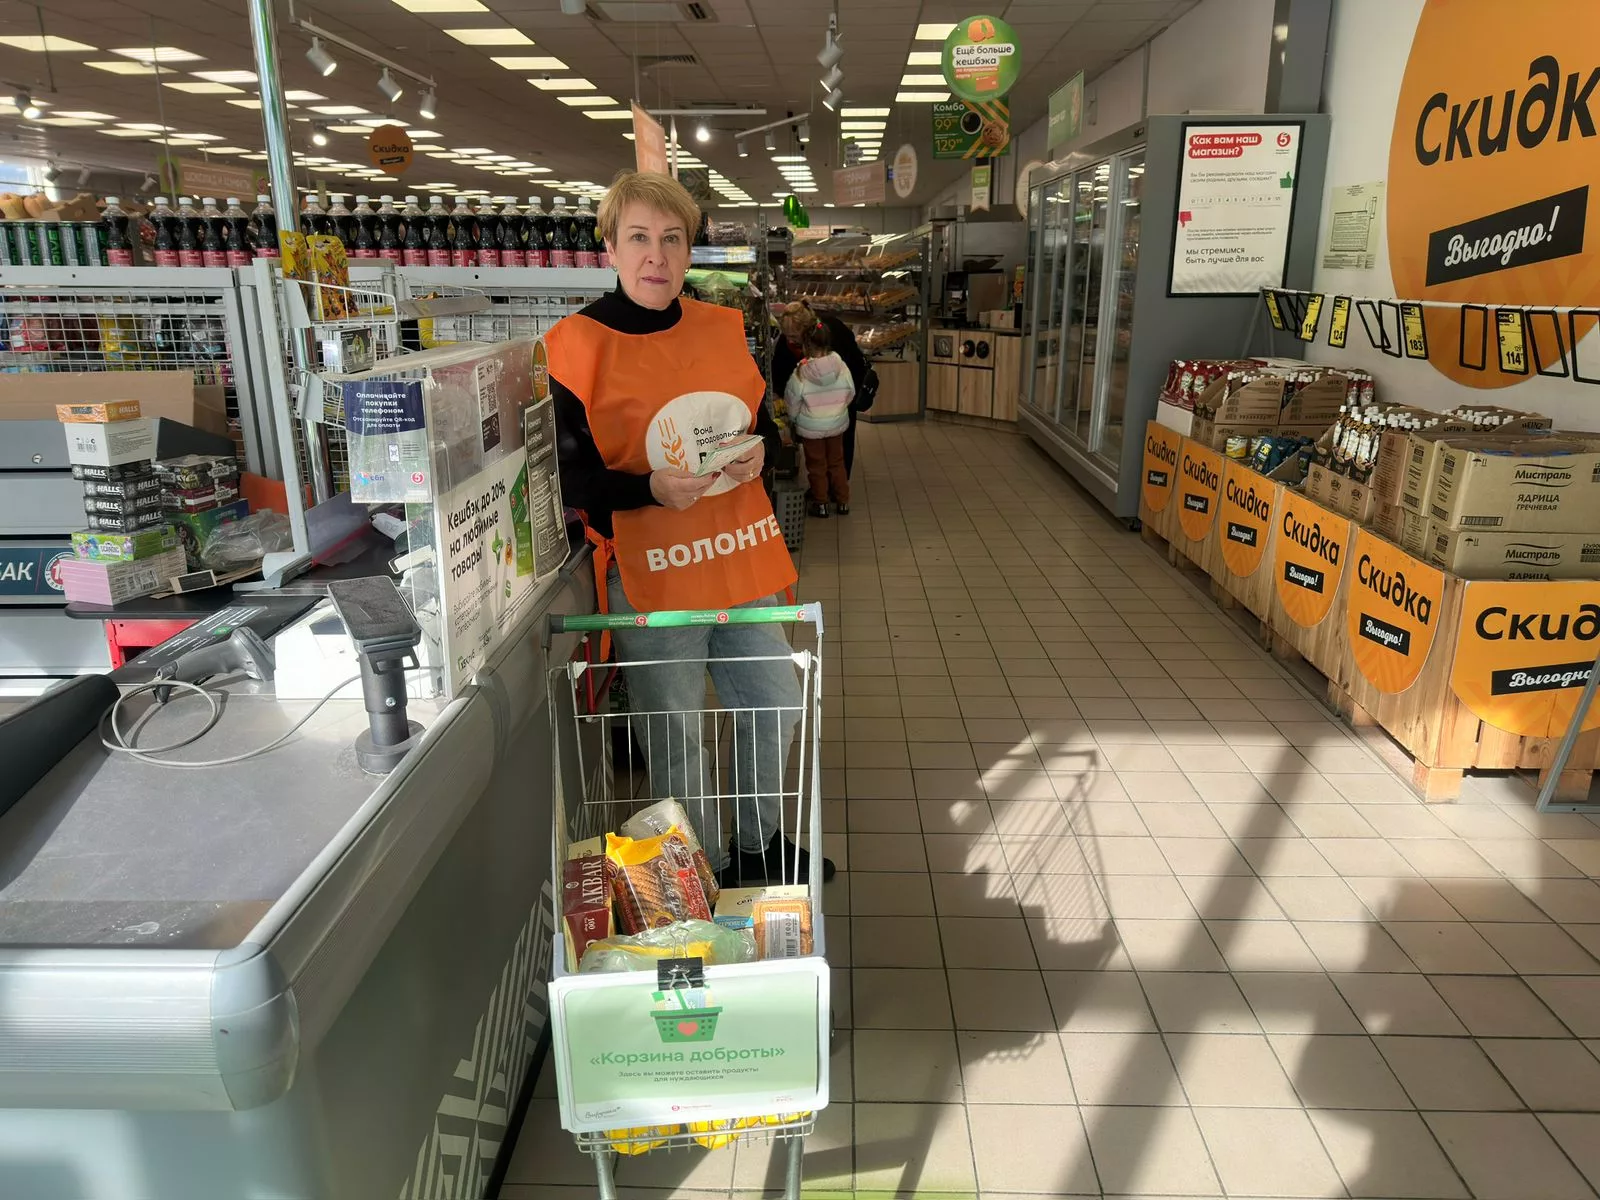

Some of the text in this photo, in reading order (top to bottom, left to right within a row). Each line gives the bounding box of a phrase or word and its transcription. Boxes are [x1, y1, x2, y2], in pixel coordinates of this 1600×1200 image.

[956, 45, 1012, 55] Ещё больше
[956, 57, 997, 65] кешбэка
[933, 102, 964, 112] Комбо
[1192, 136, 1258, 145] Как вам наш
[372, 144, 409, 153] Скидка
[1192, 147, 1240, 156] магазин?
[1444, 205, 1560, 266] Выгодно!
[1200, 247, 1245, 255] стремимся
[1185, 256, 1206, 264] быть
[1207, 256, 1234, 264] лучше
[1409, 339, 1423, 351] 183
[1506, 351, 1522, 366] 114
[356, 392, 406, 400] Оплачивайте
[360, 408, 404, 416] телефоном
[693, 426, 713, 436] Фонд
[1147, 436, 1176, 466] Скидка
[84, 468, 106, 477] HALLS
[1183, 454, 1219, 492] Скидка
[1515, 470, 1572, 482] Мистраль
[97, 485, 121, 493] HALLS
[137, 478, 160, 491] HALLS
[136, 494, 159, 507] HALLS
[1226, 478, 1270, 522] Скидка
[1517, 493, 1560, 503] ЯДРИЦА
[96, 501, 119, 510] HALLS
[447, 478, 506, 532] Кешбэк до 20%
[99, 518, 121, 526] HALLS
[139, 511, 163, 523] HALLS
[449, 538, 461, 558] на
[462, 510, 499, 547] любимые
[1231, 525, 1253, 542] Выгодно!
[1283, 511, 1340, 566] Скидка
[646, 514, 782, 572] ВОЛОНТЕ
[1505, 549, 1561, 562] Мистраль
[0, 562, 34, 581] АК
[1289, 565, 1319, 586] Выгодно!
[1358, 553, 1432, 625] Скидка
[1475, 604, 1600, 641] Скид
[1365, 619, 1403, 646] Выгодно!
[581, 859, 604, 905] AKBAR
[587, 918, 596, 930] 100
[590, 1046, 785, 1067] «Корзина доброты»
